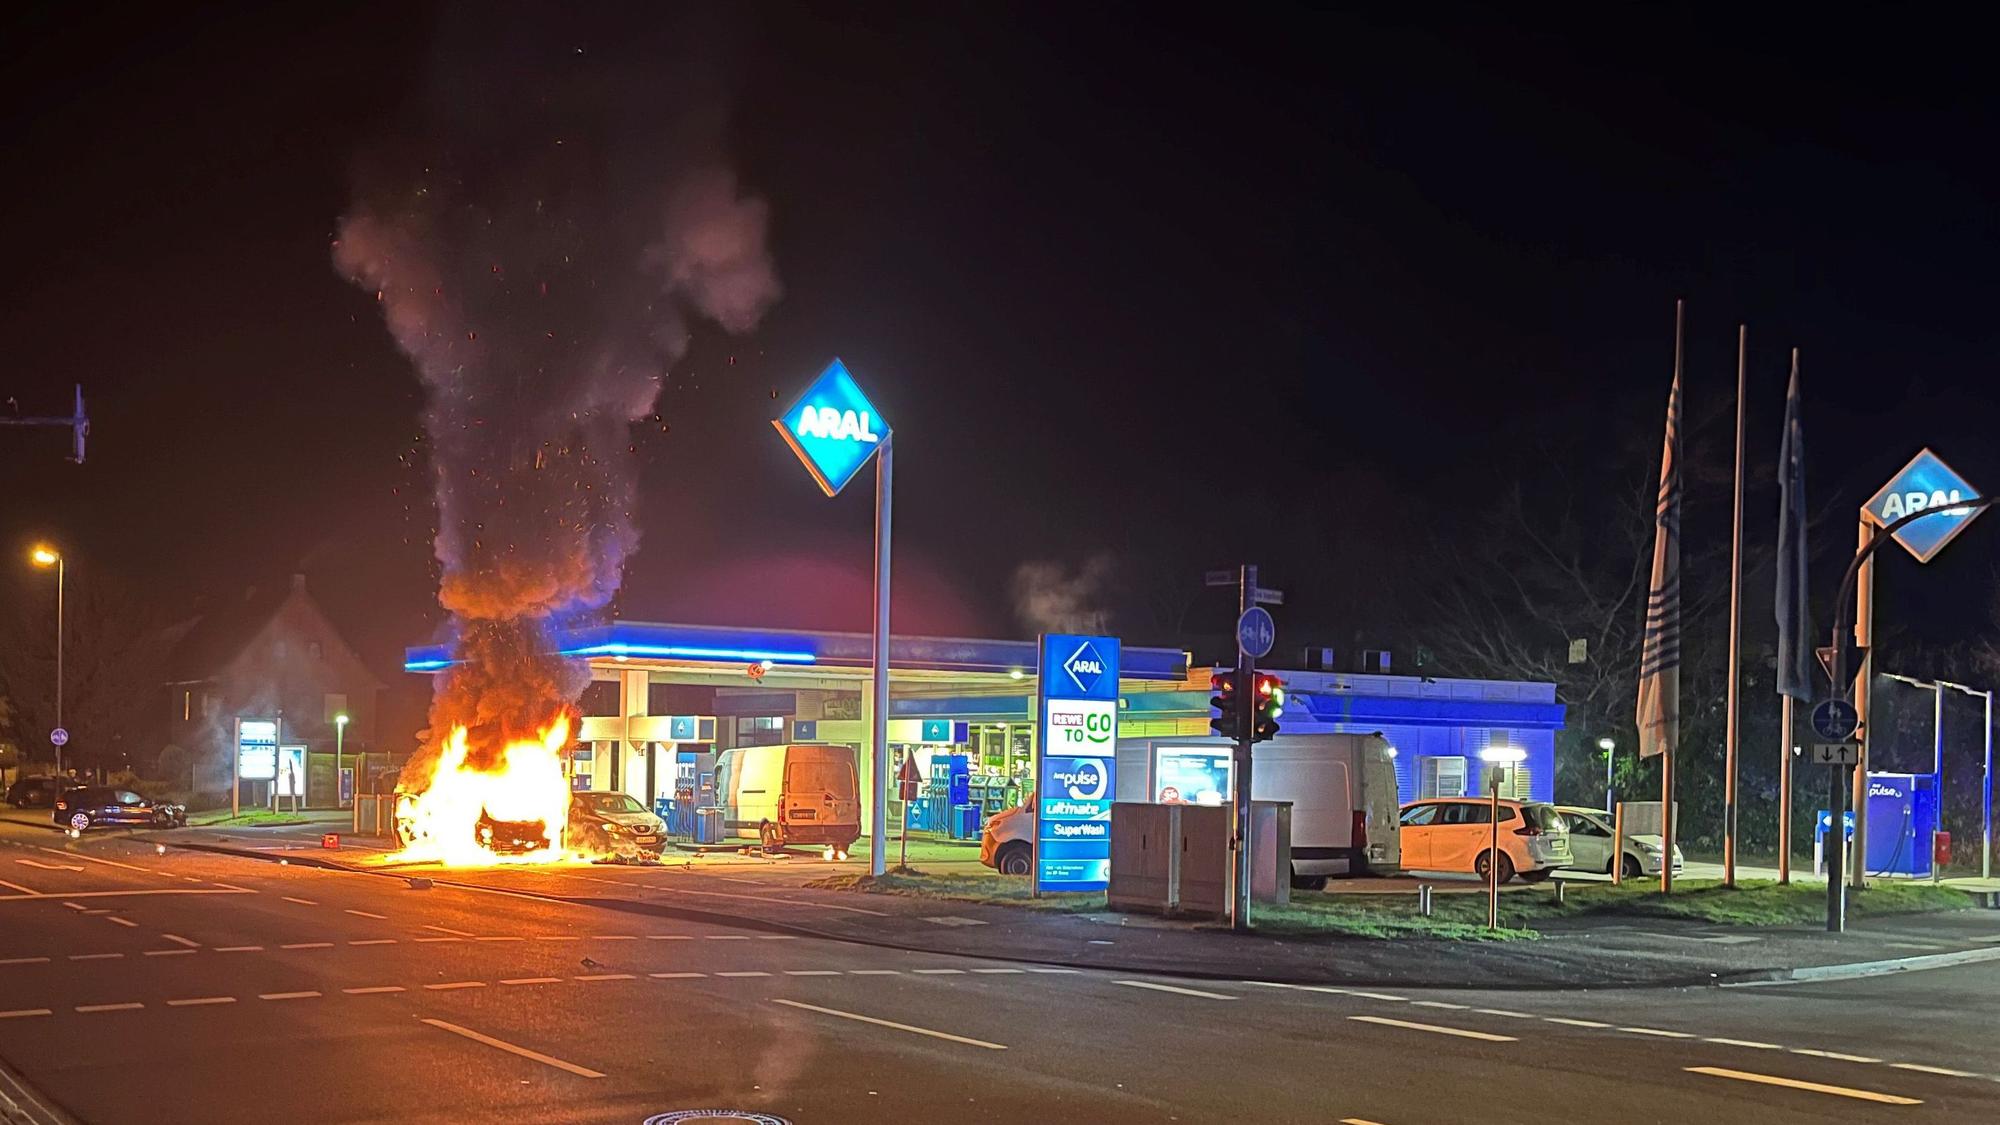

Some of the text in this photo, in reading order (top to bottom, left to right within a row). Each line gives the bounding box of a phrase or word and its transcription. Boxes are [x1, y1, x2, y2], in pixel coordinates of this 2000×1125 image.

[798, 405, 878, 442] ARAL
[1881, 489, 1970, 517] ARAL
[1072, 660, 1102, 674] ARAL
[1053, 713, 1111, 732] REWE GO
[1064, 729, 1084, 742] TO
[1064, 770, 1098, 788] pulse
[1868, 786, 1897, 798] pulse
[1045, 801, 1100, 815] ultimate
[1053, 823, 1105, 837] SuperWash
